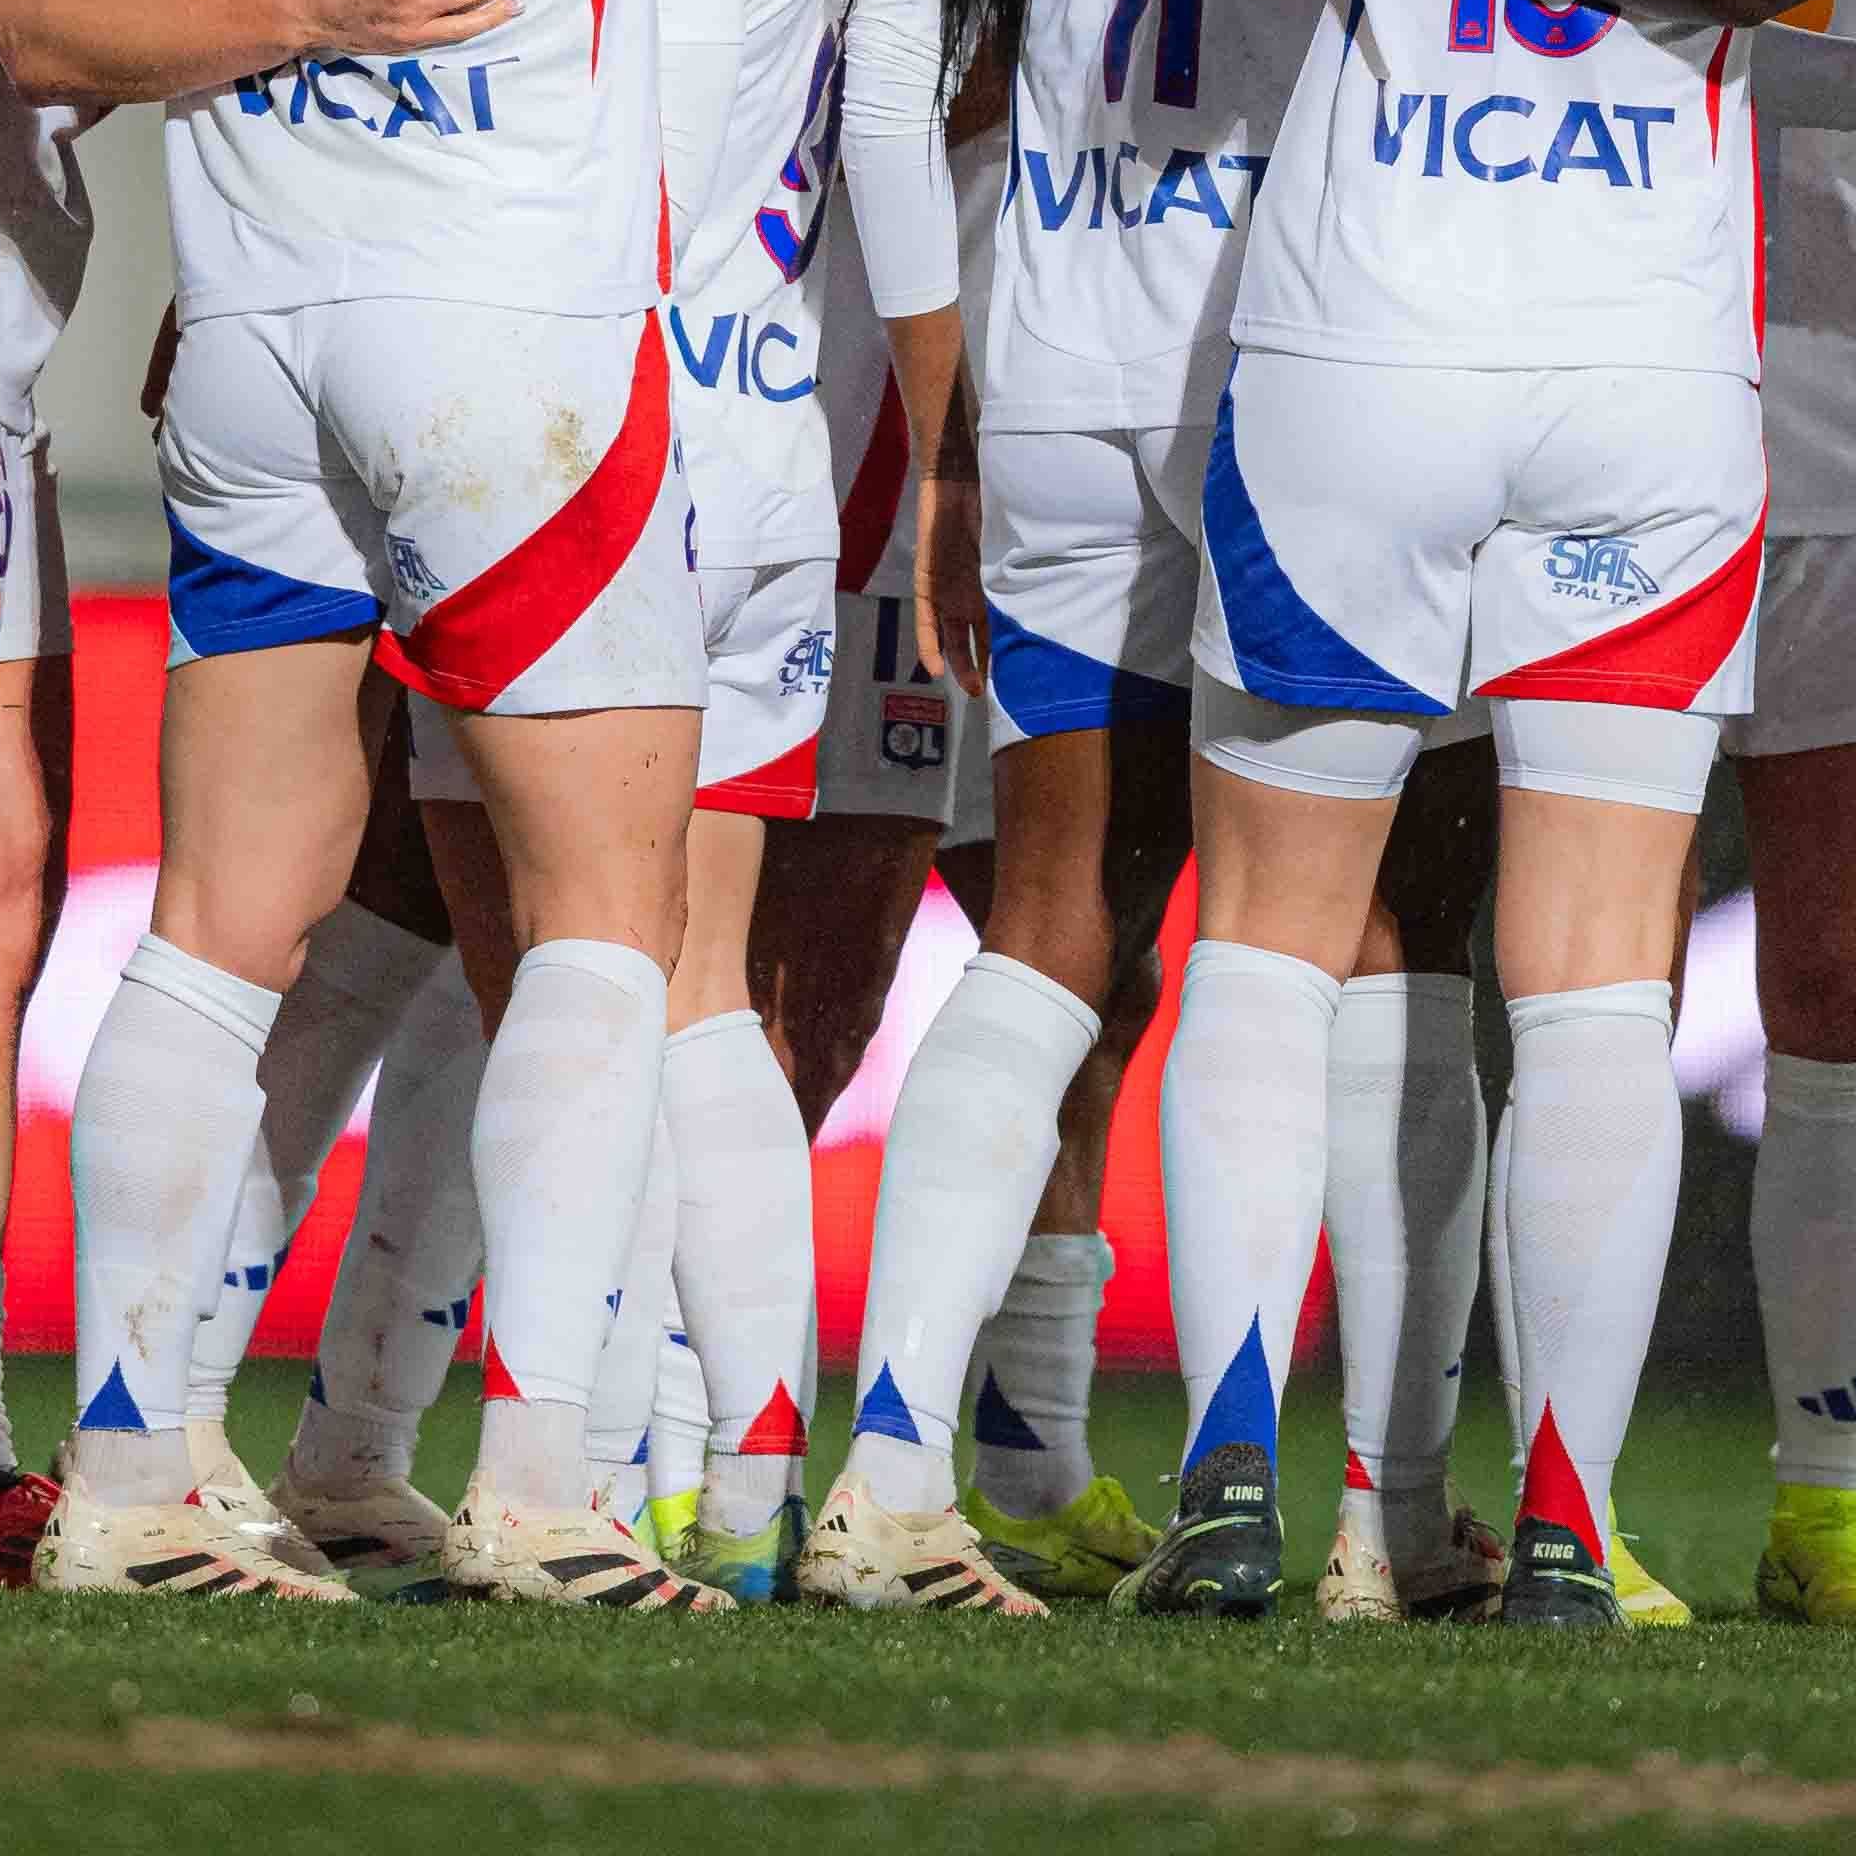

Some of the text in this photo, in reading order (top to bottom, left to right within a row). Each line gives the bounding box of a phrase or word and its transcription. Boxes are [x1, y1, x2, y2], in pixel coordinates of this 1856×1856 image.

[1374, 79, 1675, 189] VICAT
[1551, 581, 1601, 601] STAL
[1224, 1486, 1263, 1501] KING
[1533, 1543, 1575, 1560] KING
